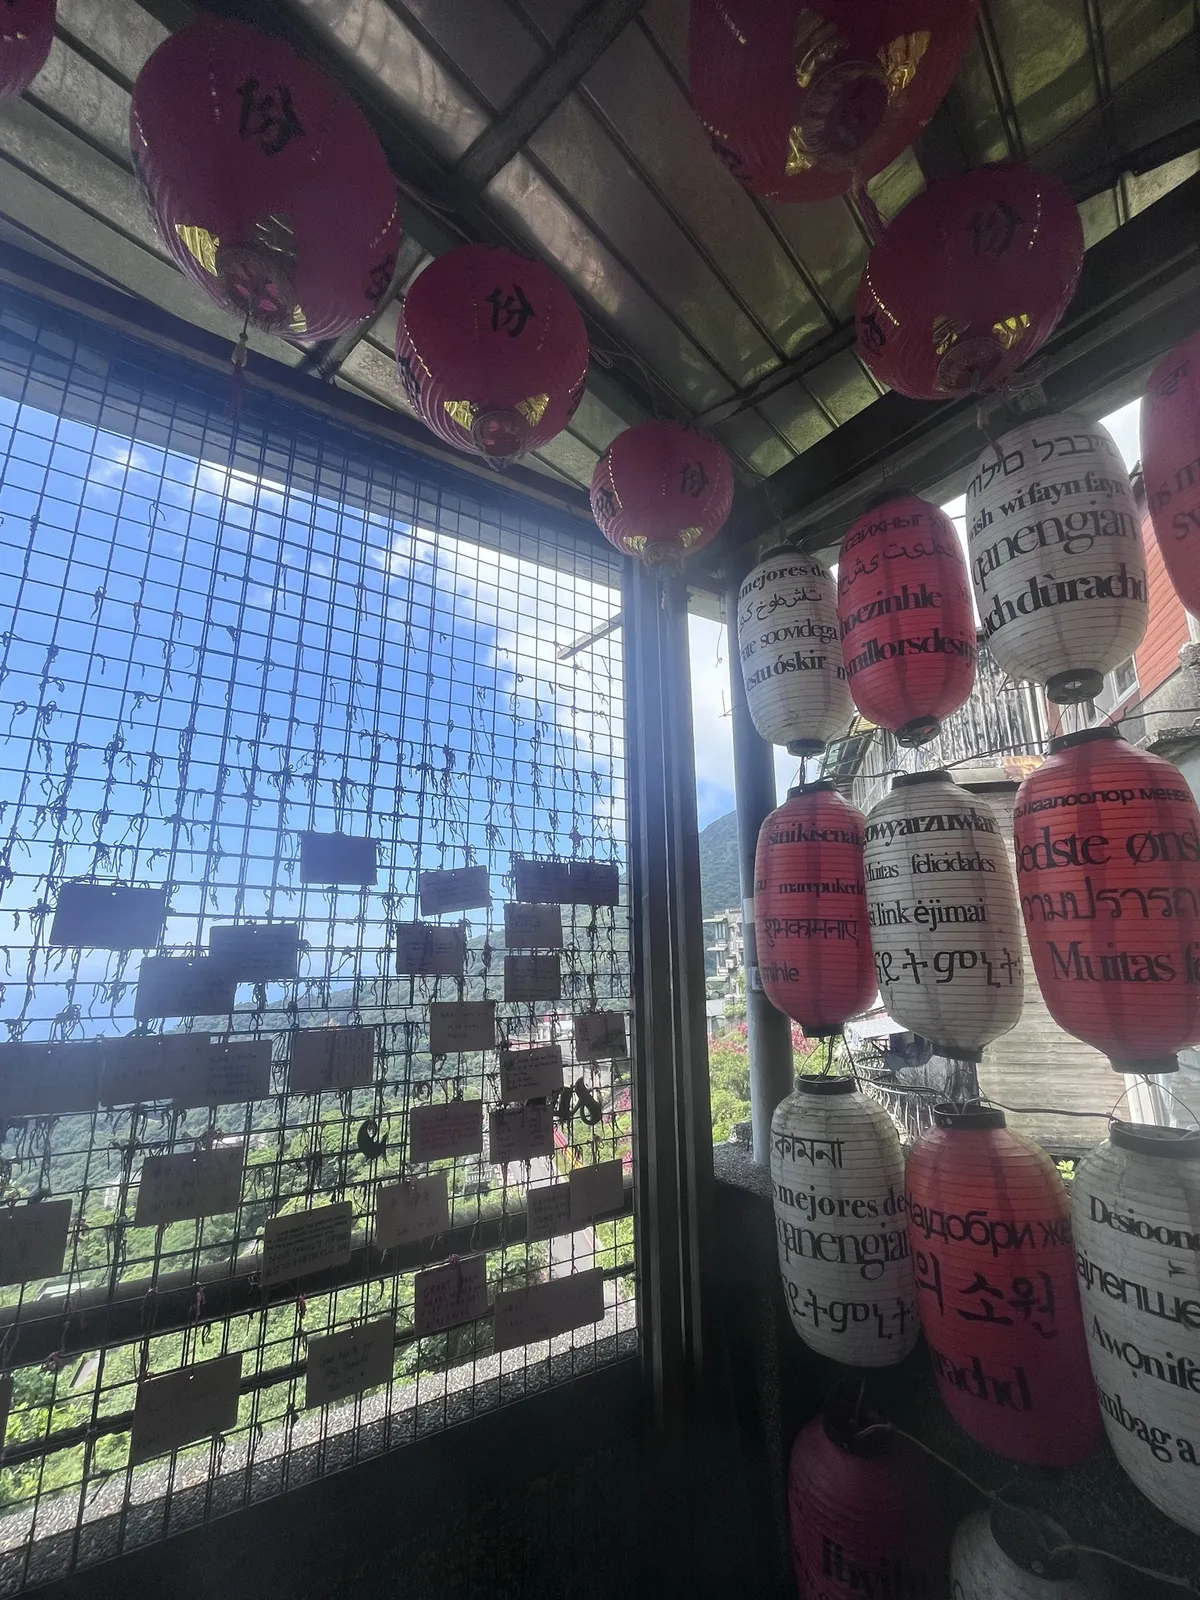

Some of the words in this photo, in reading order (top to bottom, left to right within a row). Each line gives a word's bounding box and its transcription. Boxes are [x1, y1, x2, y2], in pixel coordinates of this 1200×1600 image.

[485, 283, 538, 339] 份
[910, 851, 997, 875] felicidades
[1047, 940, 1177, 983] Muitas
[778, 1184, 880, 1222] mejores
